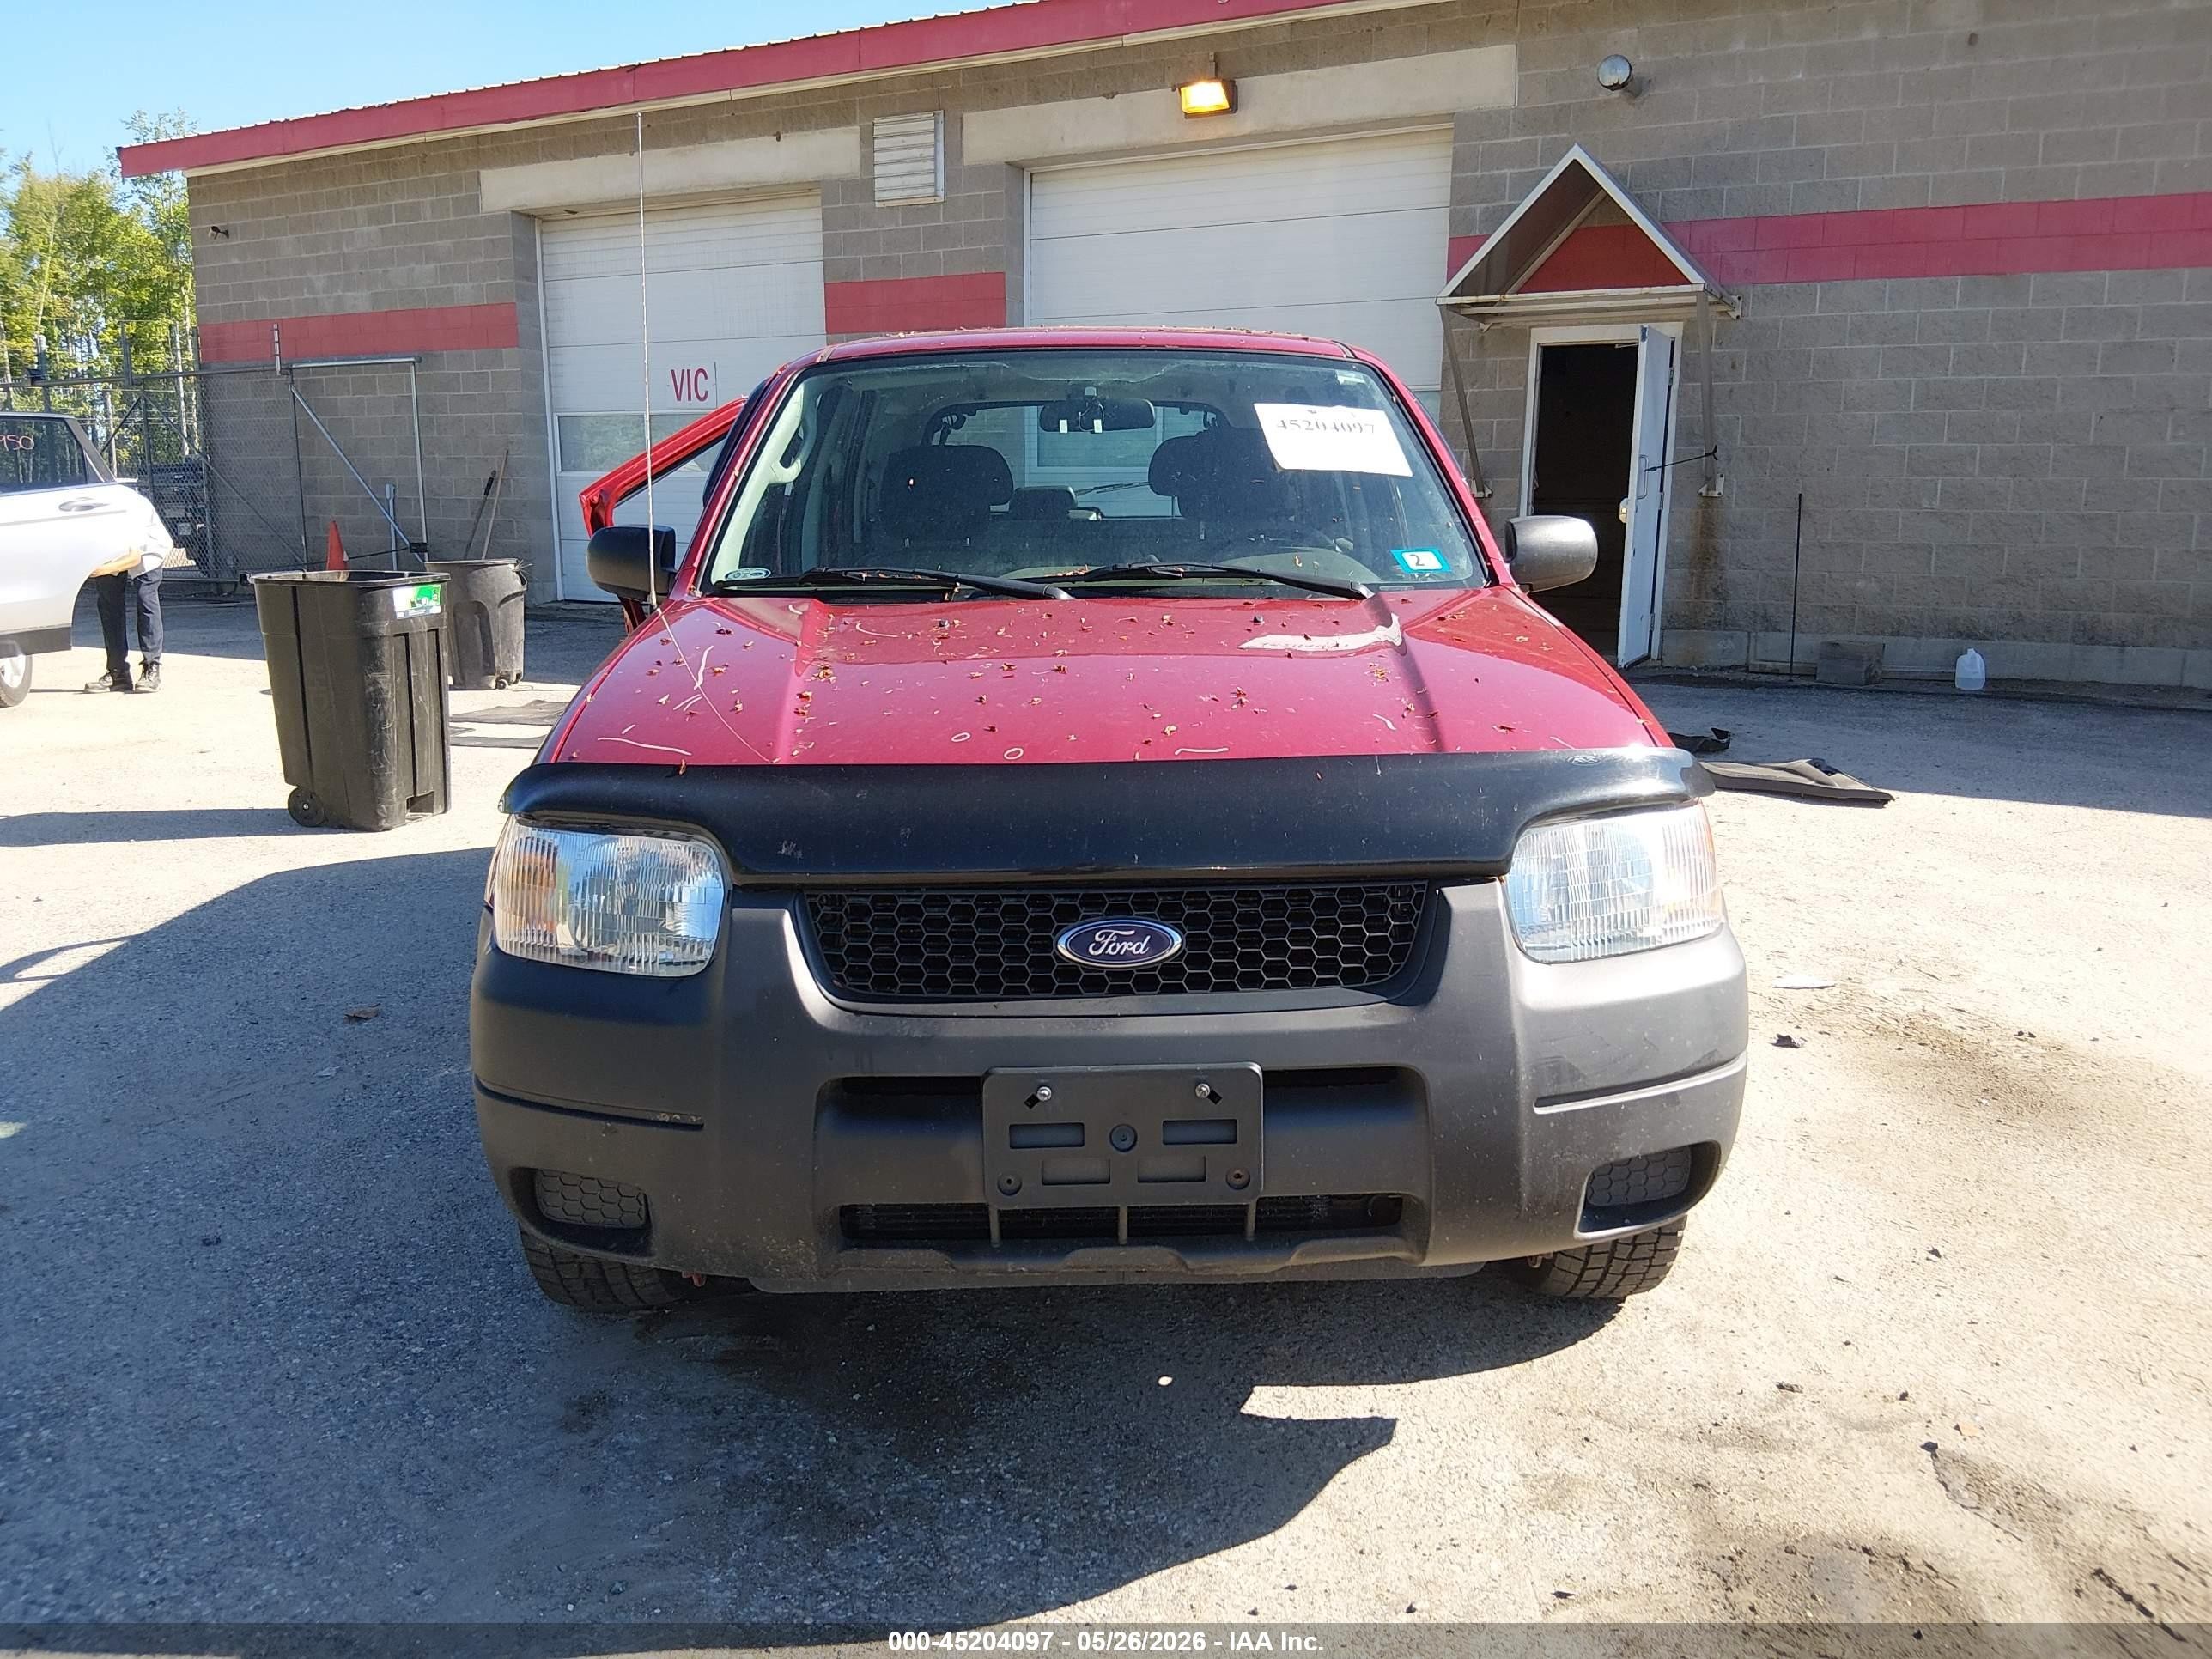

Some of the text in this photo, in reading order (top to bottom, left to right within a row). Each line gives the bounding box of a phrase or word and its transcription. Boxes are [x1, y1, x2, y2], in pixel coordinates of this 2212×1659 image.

[670, 368, 708, 402] VIC
[1409, 554, 1425, 567] 2
[1088, 929, 1151, 956] Ford
